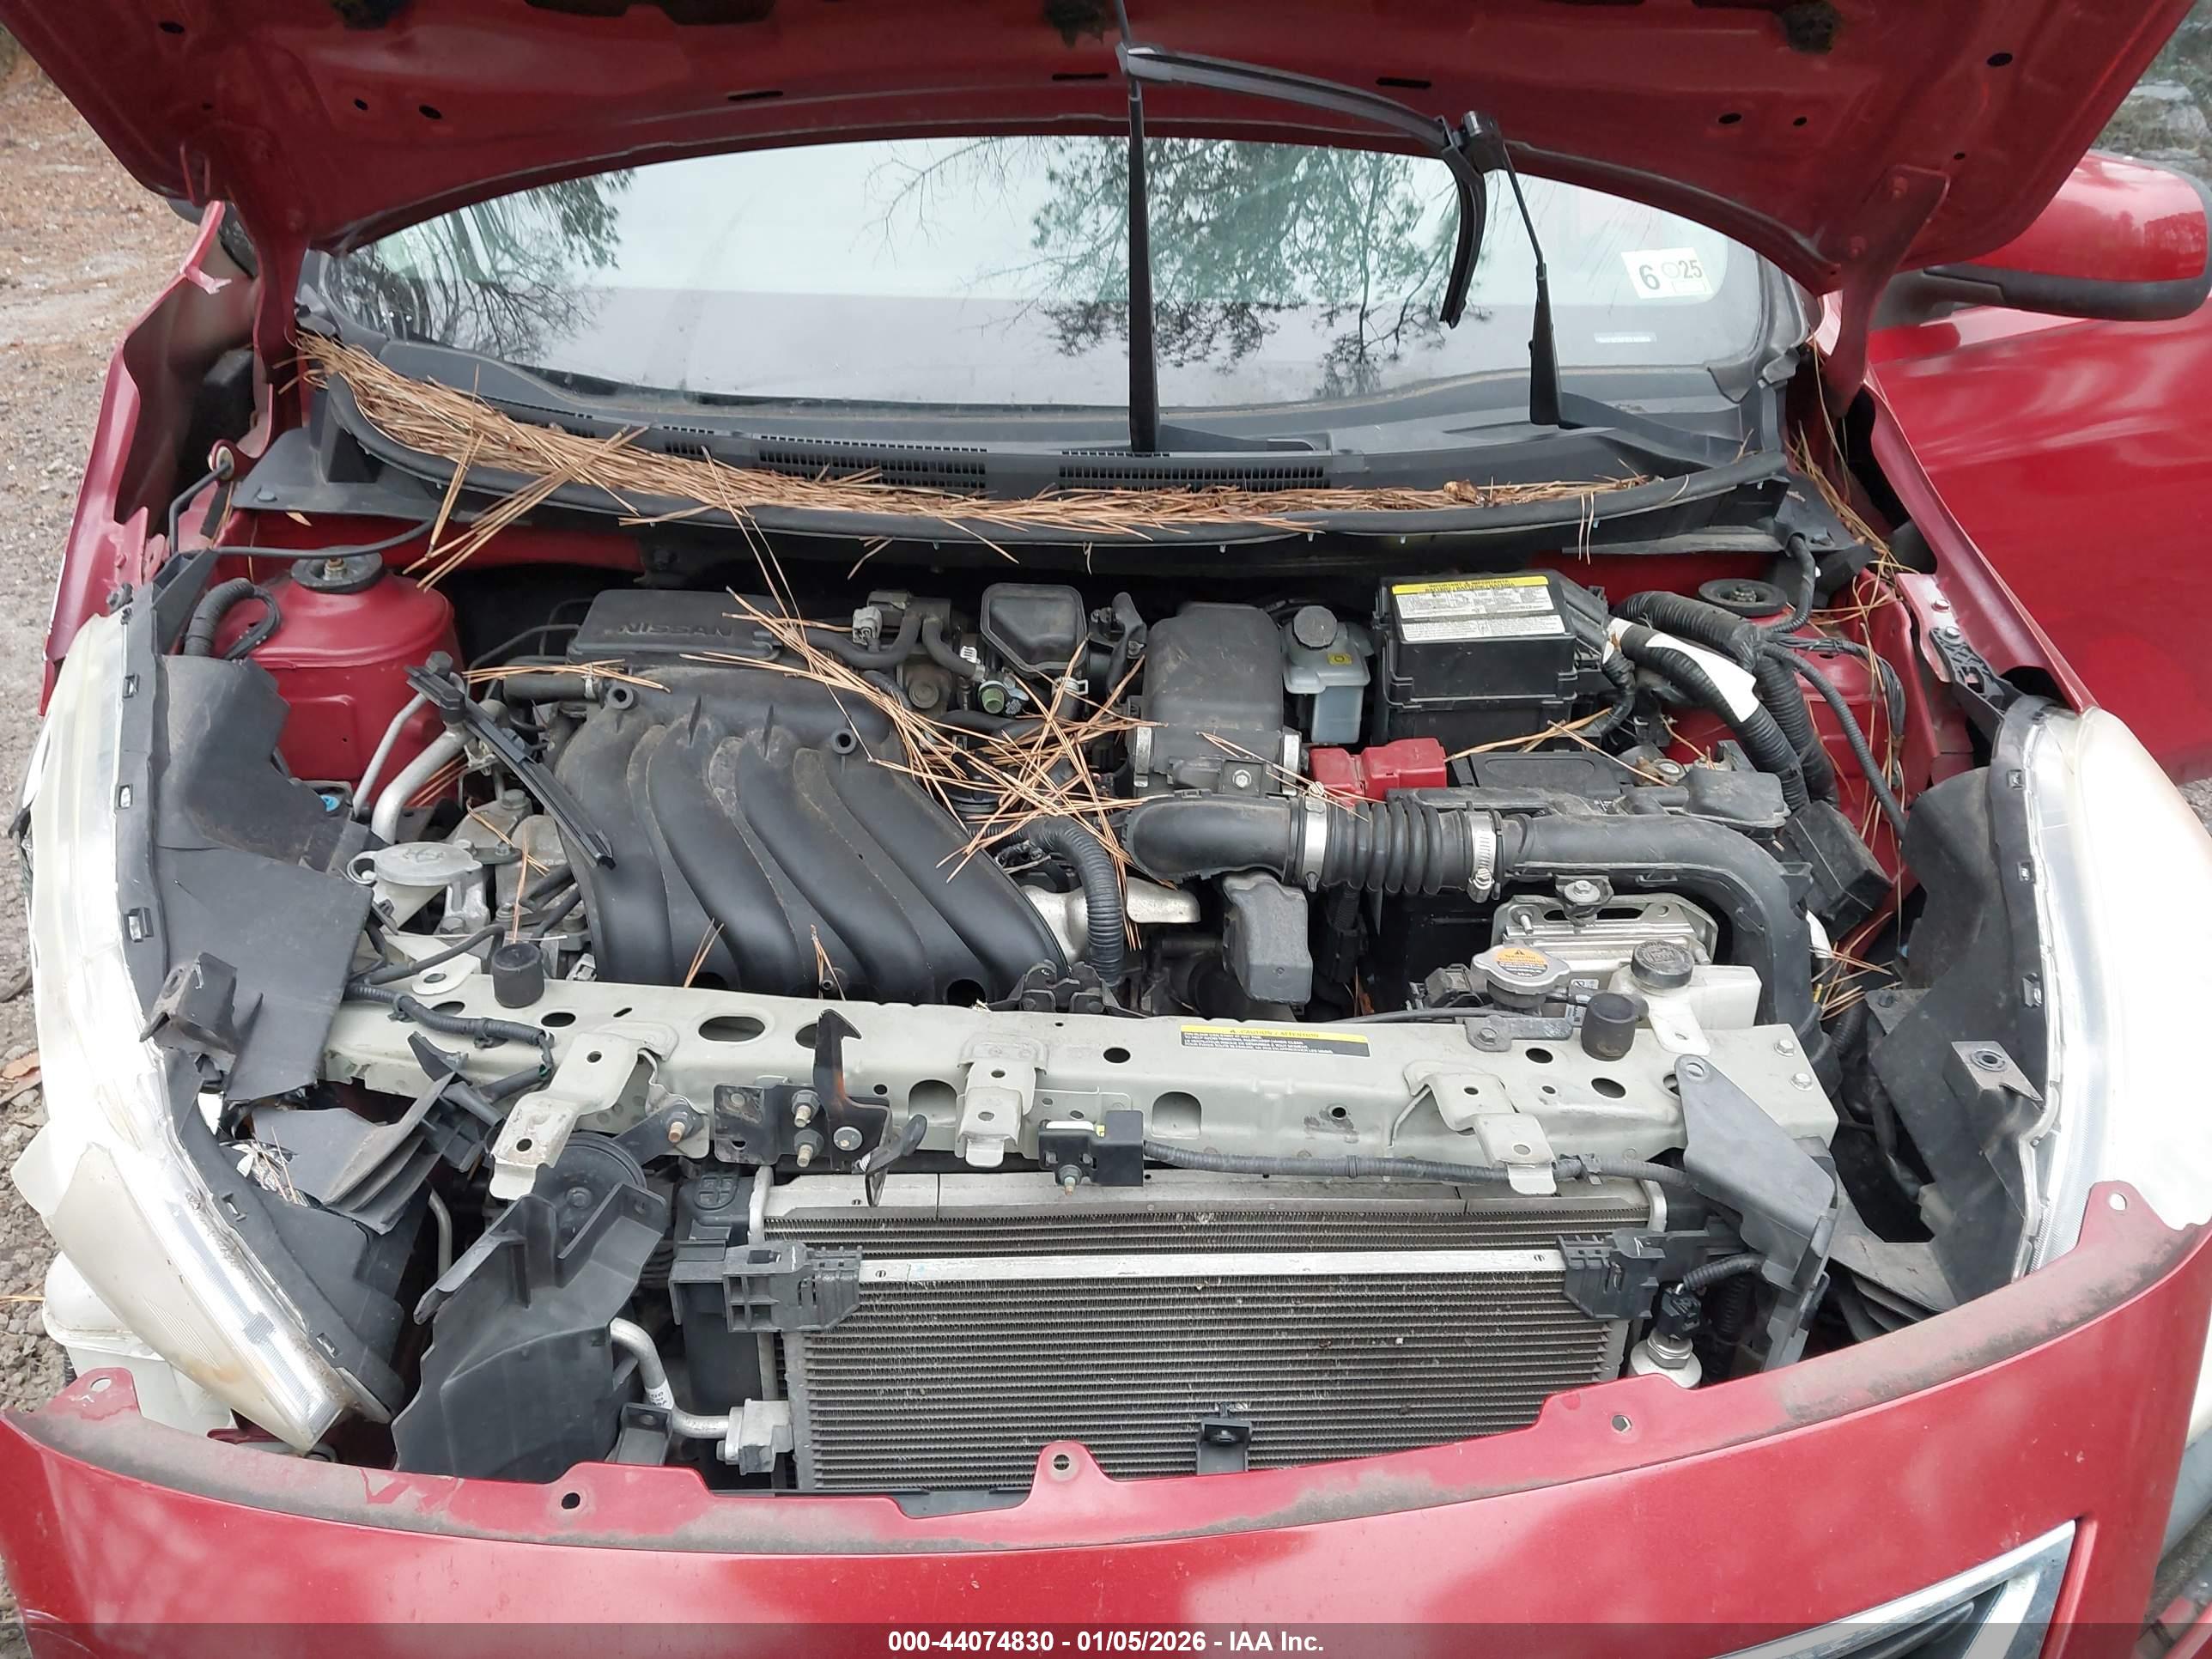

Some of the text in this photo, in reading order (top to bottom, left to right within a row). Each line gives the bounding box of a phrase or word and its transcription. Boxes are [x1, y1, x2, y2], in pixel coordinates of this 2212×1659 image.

[1638, 259, 1703, 290] 6 25
[617, 622, 734, 637] NISSAN
